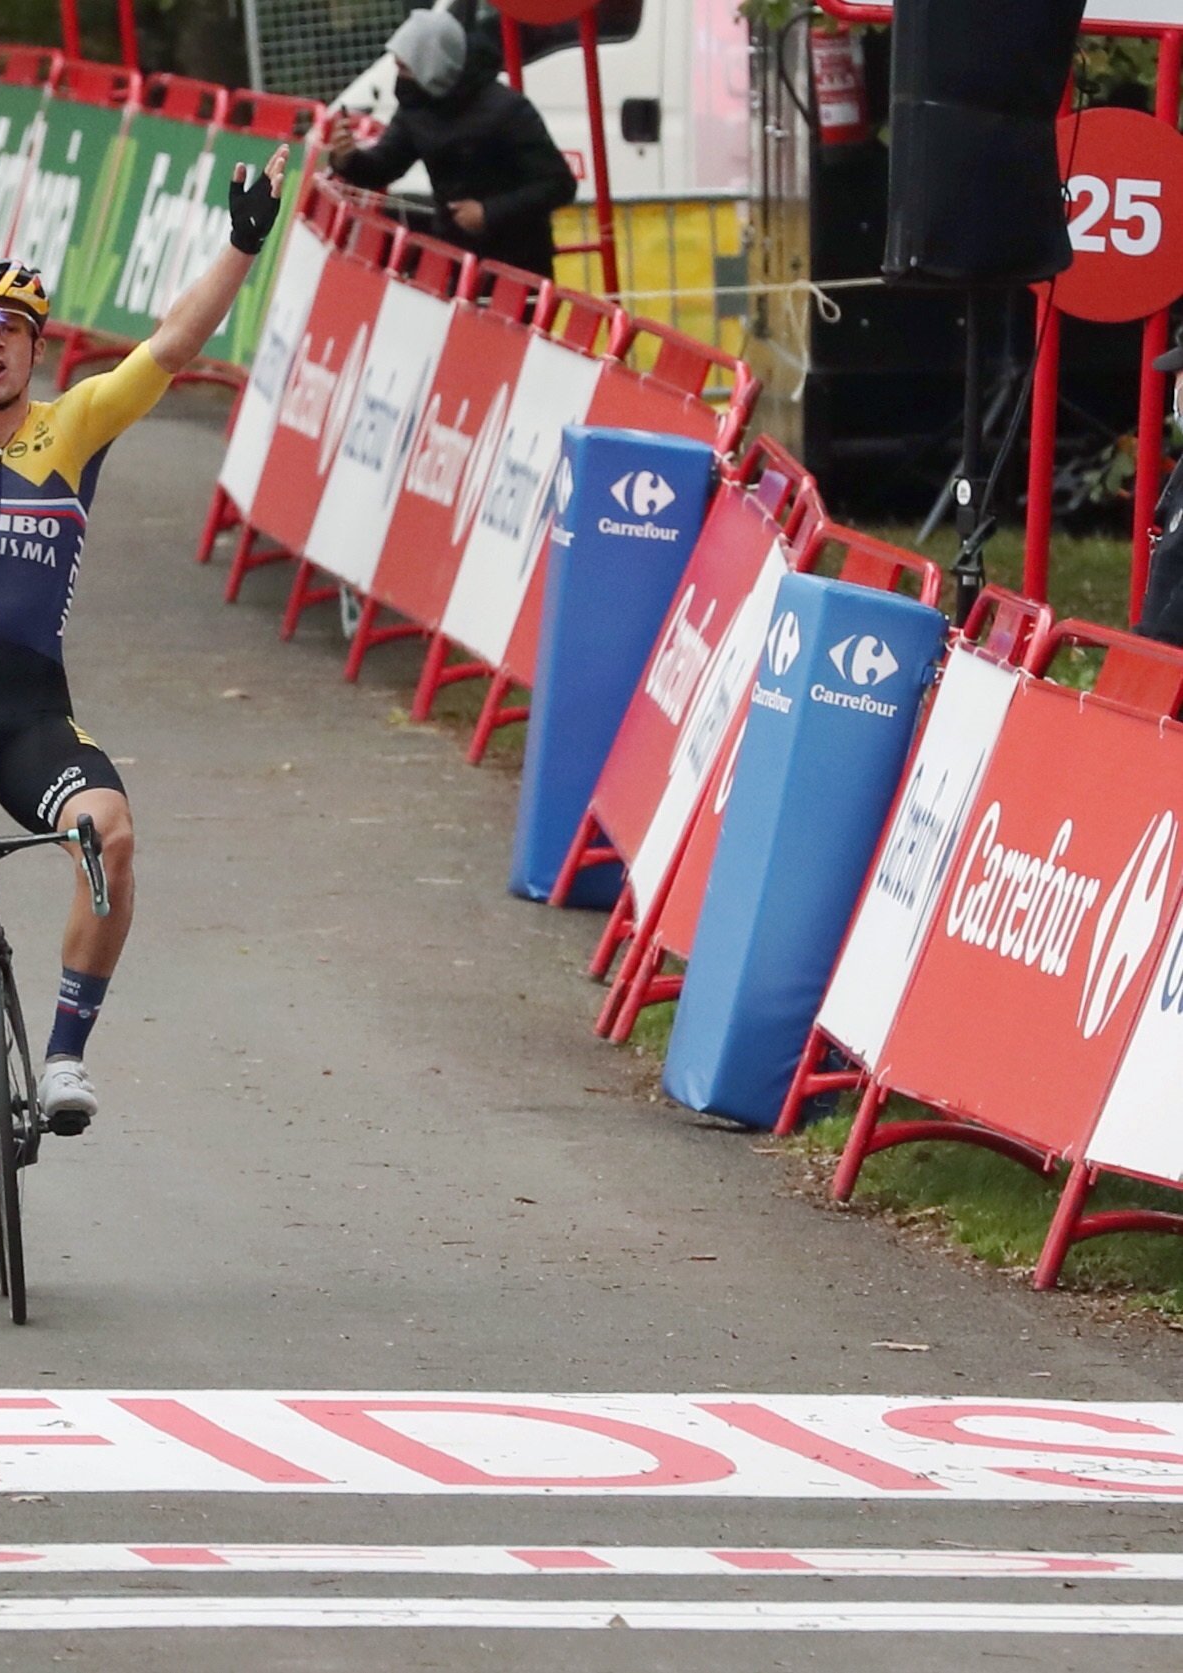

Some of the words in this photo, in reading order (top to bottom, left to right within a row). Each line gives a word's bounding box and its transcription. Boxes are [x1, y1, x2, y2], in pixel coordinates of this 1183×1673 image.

[1062, 175, 1163, 256] 25
[598, 517, 680, 542] Carrefour
[809, 683, 898, 718] Carrefour
[946, 801, 1101, 977] Carrefour
